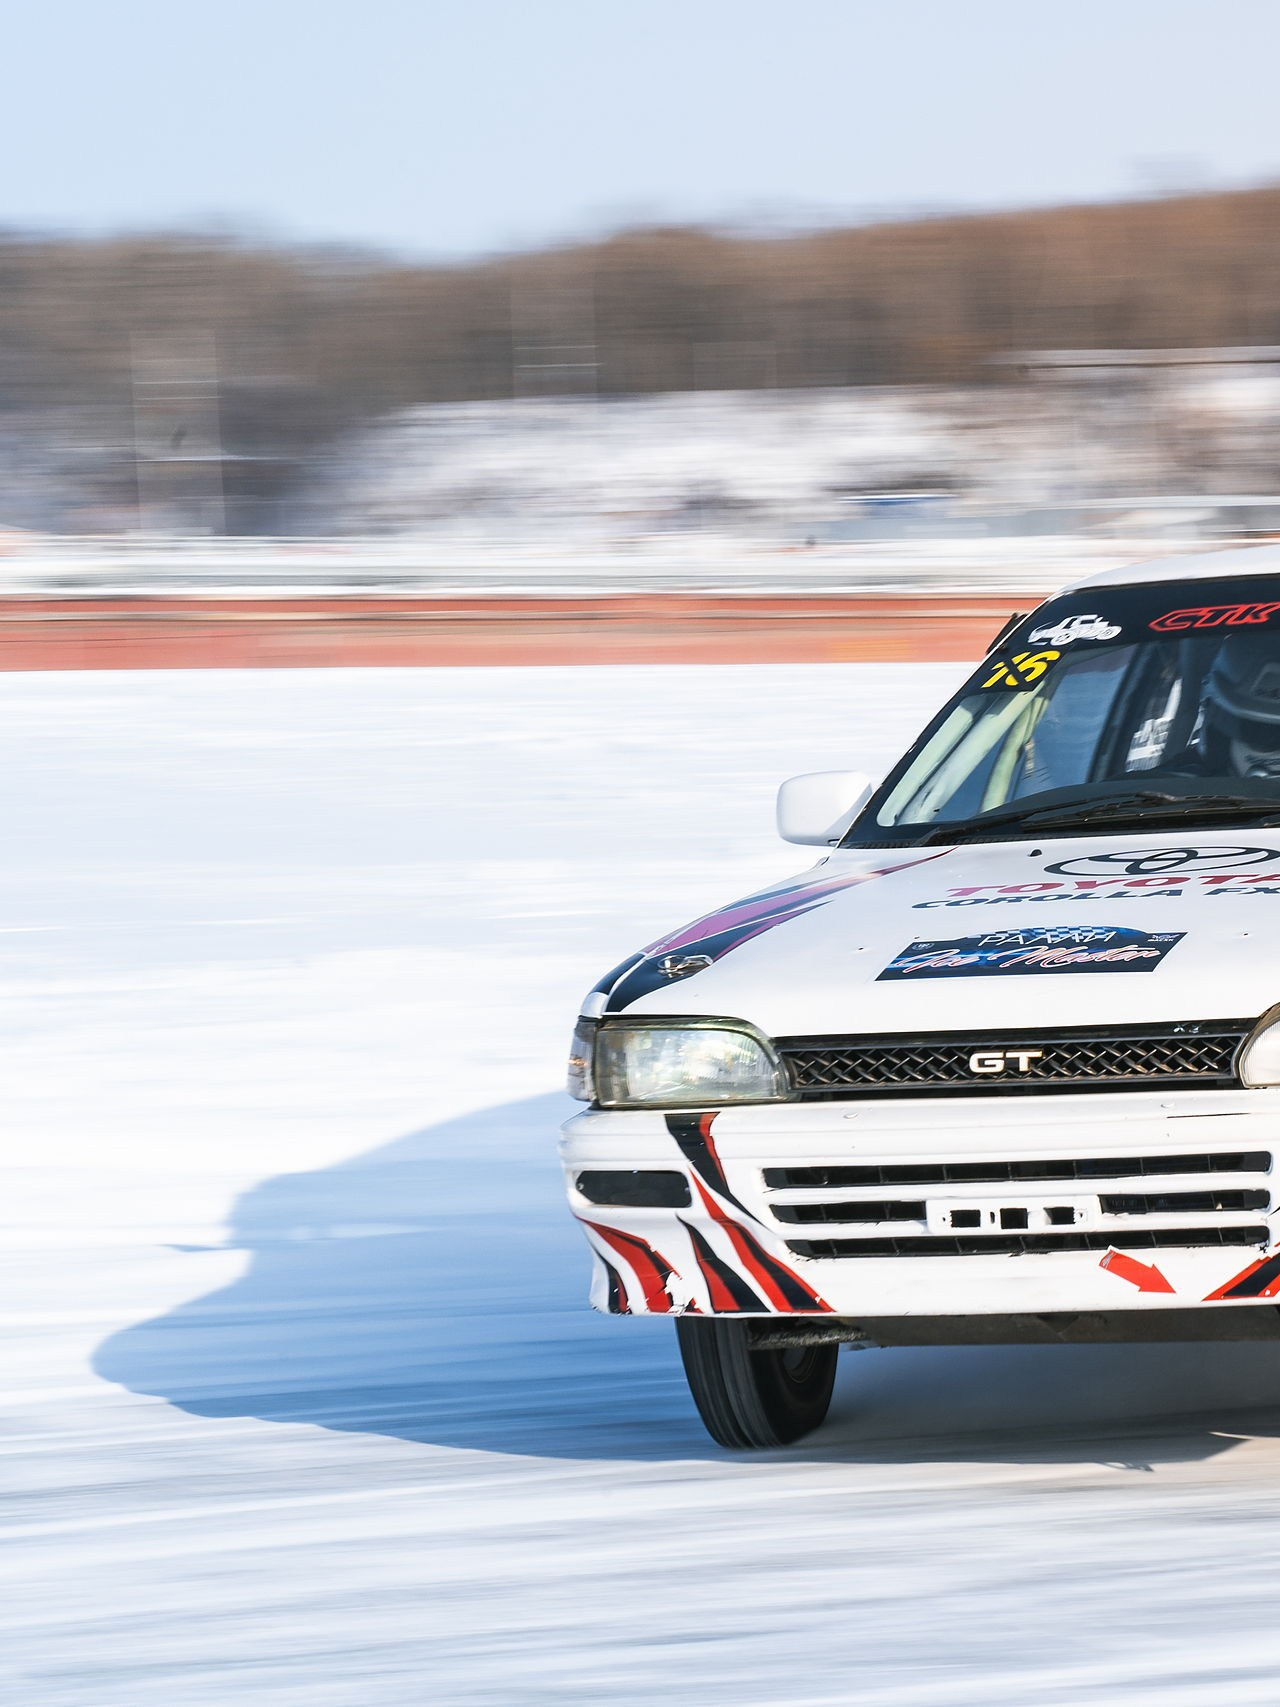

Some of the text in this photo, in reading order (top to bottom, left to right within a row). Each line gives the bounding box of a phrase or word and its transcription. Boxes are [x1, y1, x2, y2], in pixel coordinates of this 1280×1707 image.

[911, 888, 1183, 909] COROLLA
[988, 944, 1162, 969] Master
[969, 1049, 1043, 1073] GT
